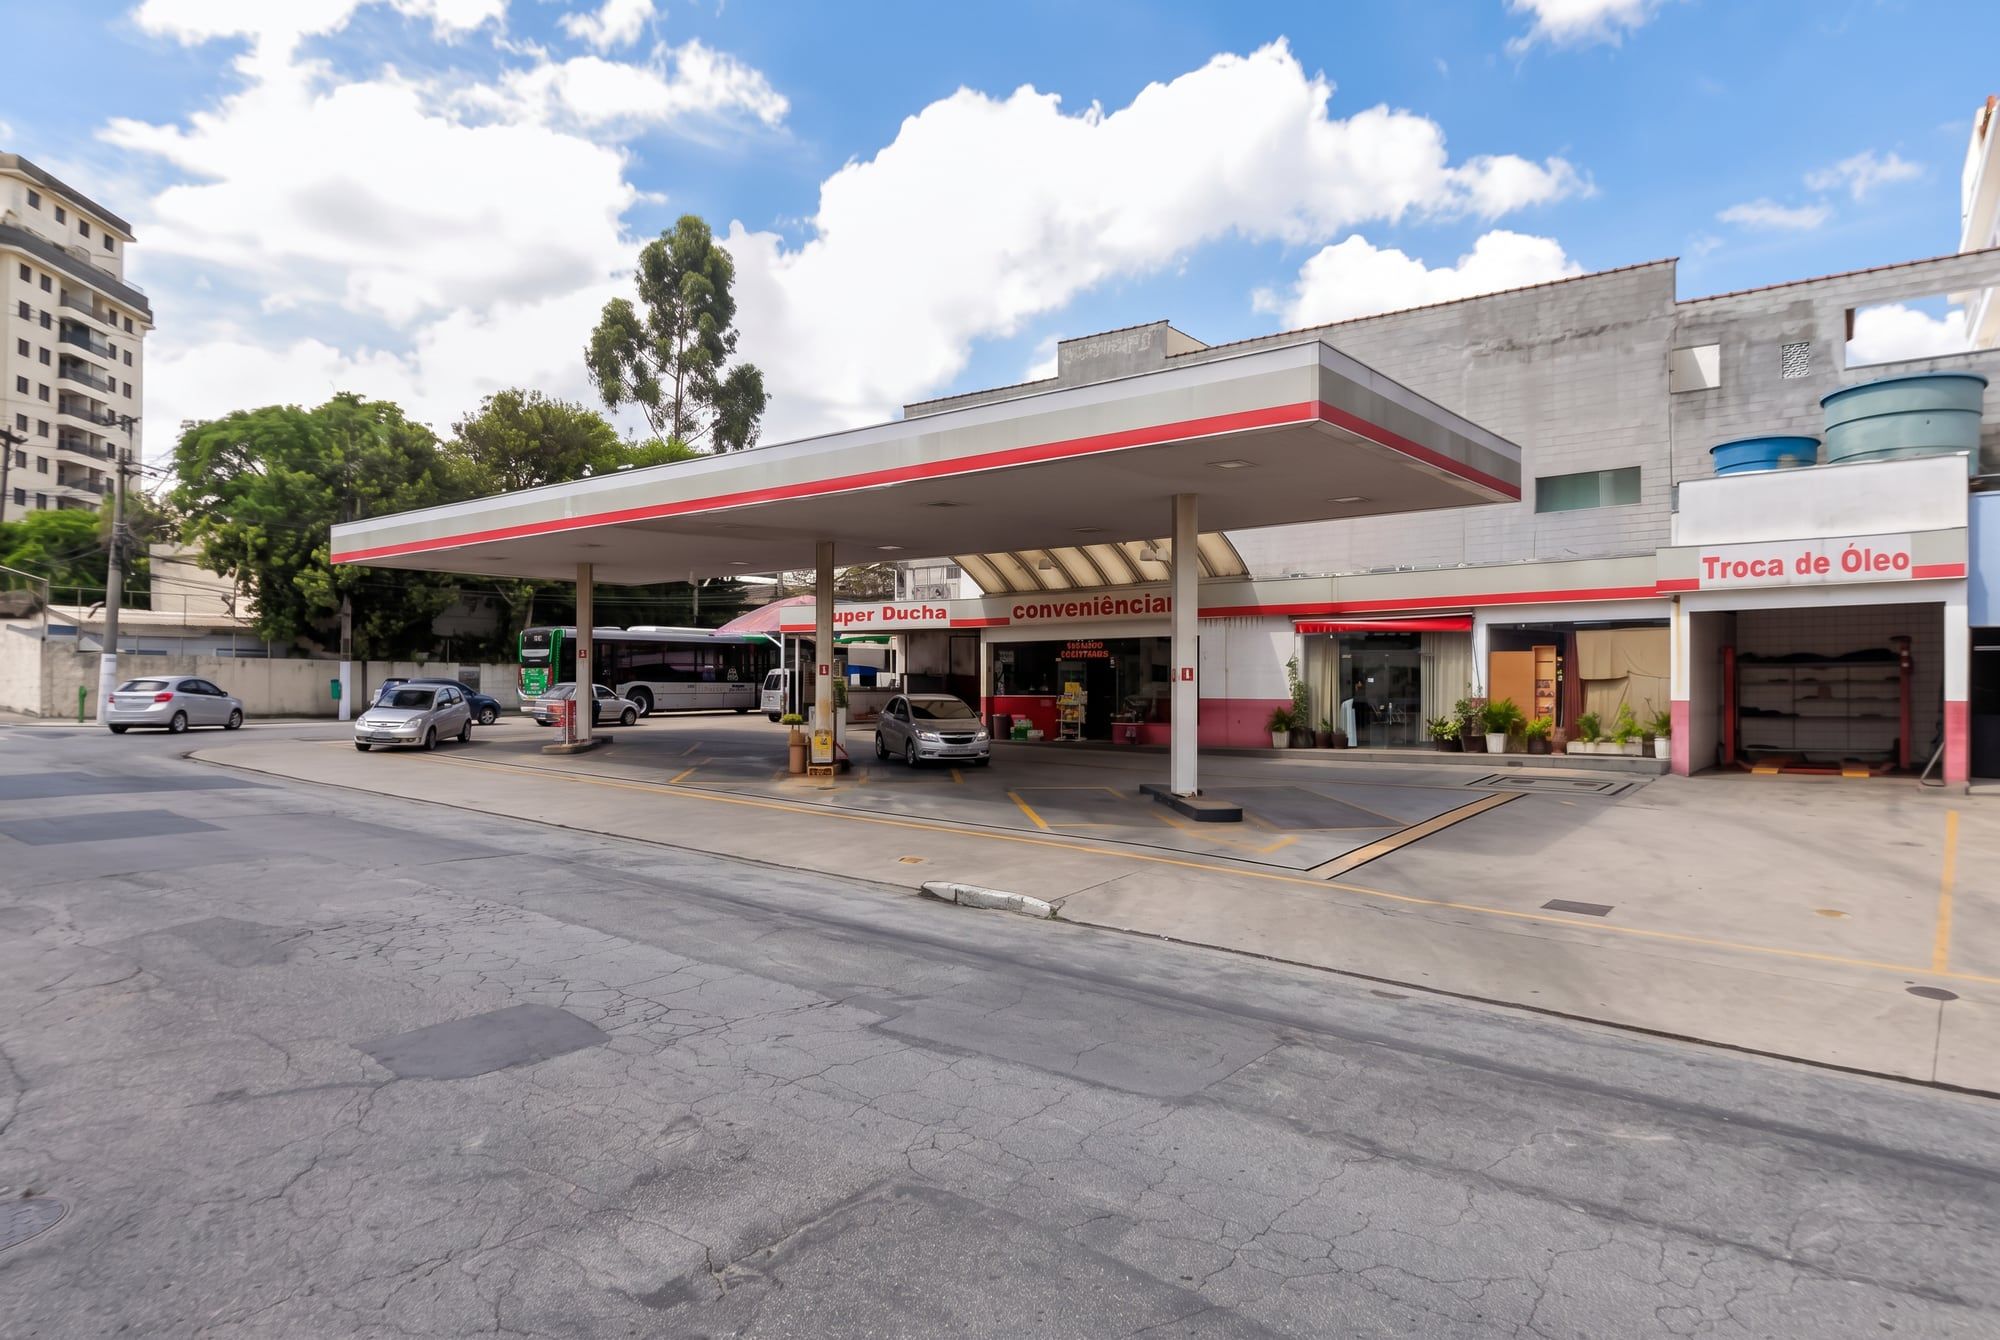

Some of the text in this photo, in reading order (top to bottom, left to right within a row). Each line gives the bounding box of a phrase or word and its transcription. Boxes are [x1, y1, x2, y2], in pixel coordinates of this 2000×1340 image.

[1702, 543, 1910, 580] Troca de Óleo
[832, 605, 947, 627] uper Ducha
